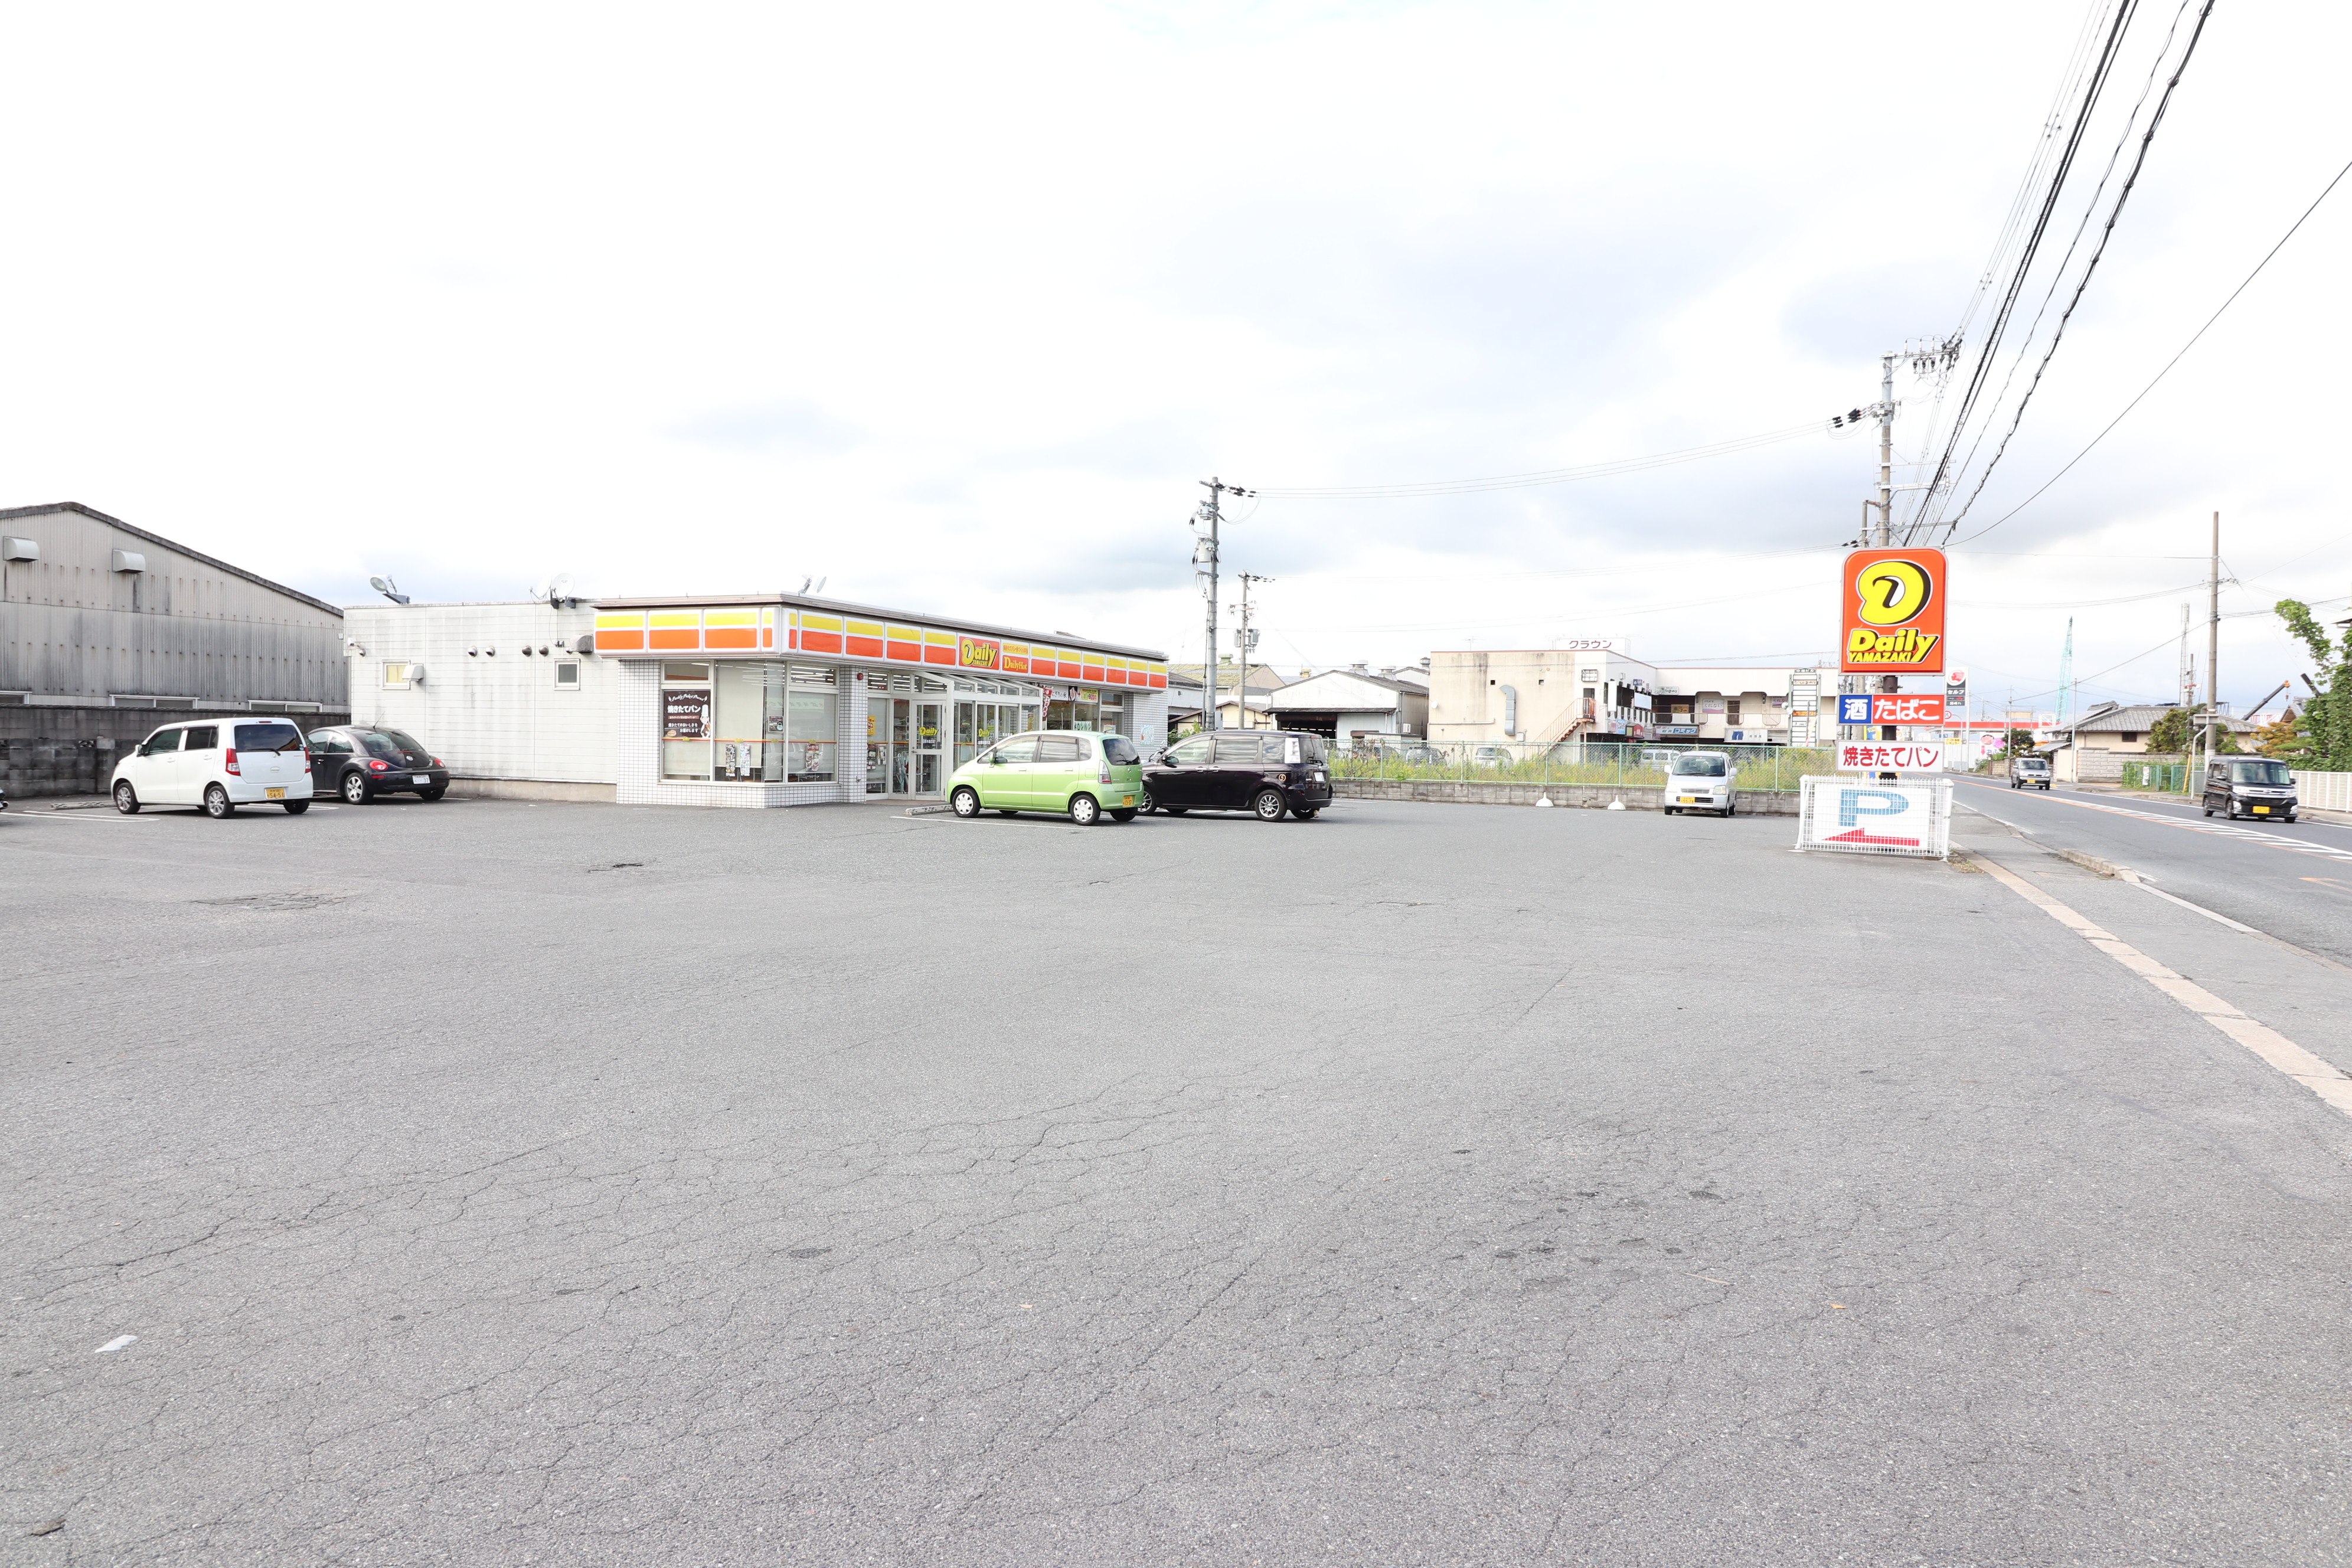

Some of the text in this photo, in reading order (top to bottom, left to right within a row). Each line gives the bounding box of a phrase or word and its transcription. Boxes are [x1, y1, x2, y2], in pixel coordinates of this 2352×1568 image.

[962, 639, 997, 667] Daily
[1569, 641, 1612, 649] クラウン
[1848, 629, 1939, 662] Daily
[1848, 652, 1913, 662] YAMAZAKI
[667, 705, 701, 714] 焼きたてパン
[1844, 698, 1868, 720] 酒
[1874, 699, 1940, 720] たばこ
[919, 727, 939, 736] Daily
[1843, 746, 1939, 767] 焼きたてパン
[1838, 789, 1909, 827] P
